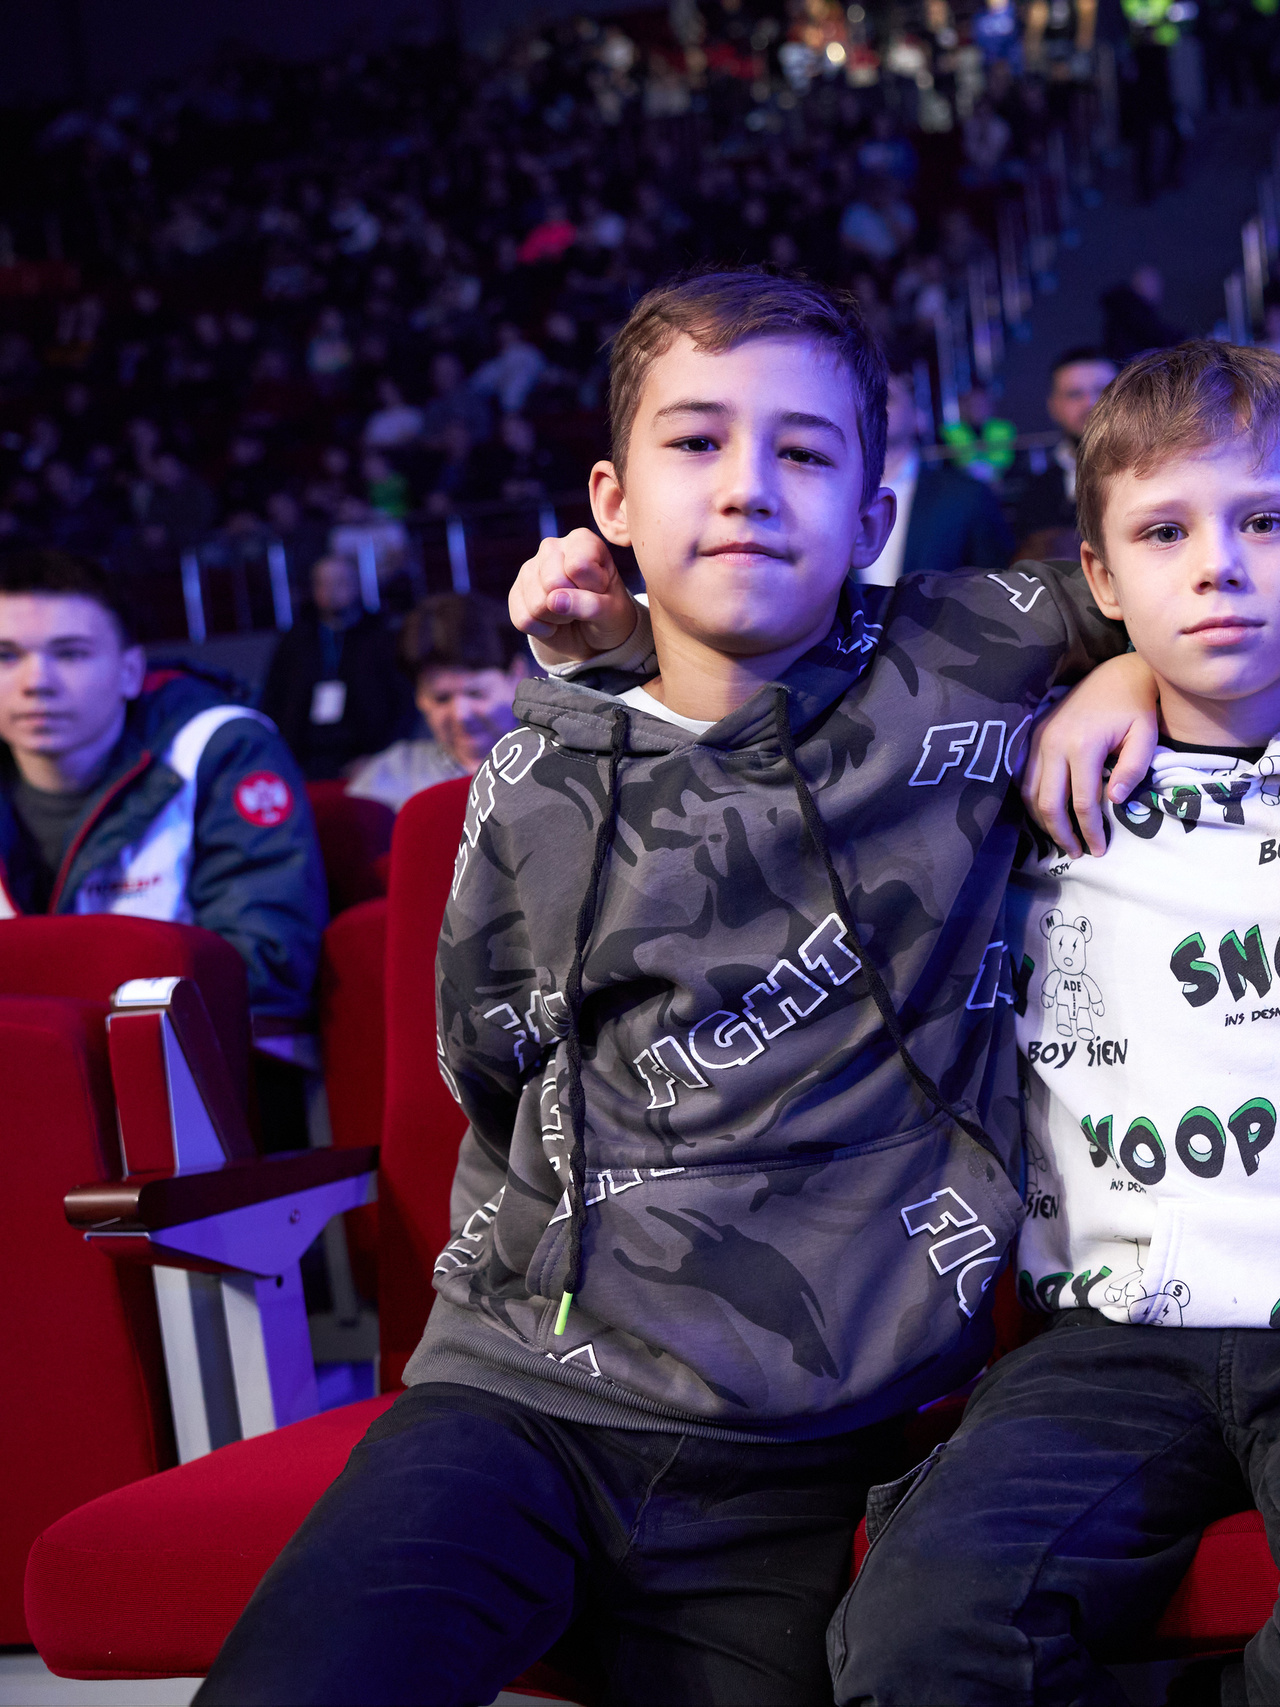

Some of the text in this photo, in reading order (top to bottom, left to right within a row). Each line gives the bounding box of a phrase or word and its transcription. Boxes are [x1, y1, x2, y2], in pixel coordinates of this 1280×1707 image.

[908, 714, 1032, 787] FI
[1046, 915, 1055, 929] M
[1079, 920, 1088, 933] S
[1063, 980, 1082, 992] ADE
[1028, 1041, 1077, 1069] BOY
[1172, 1284, 1183, 1297] S
